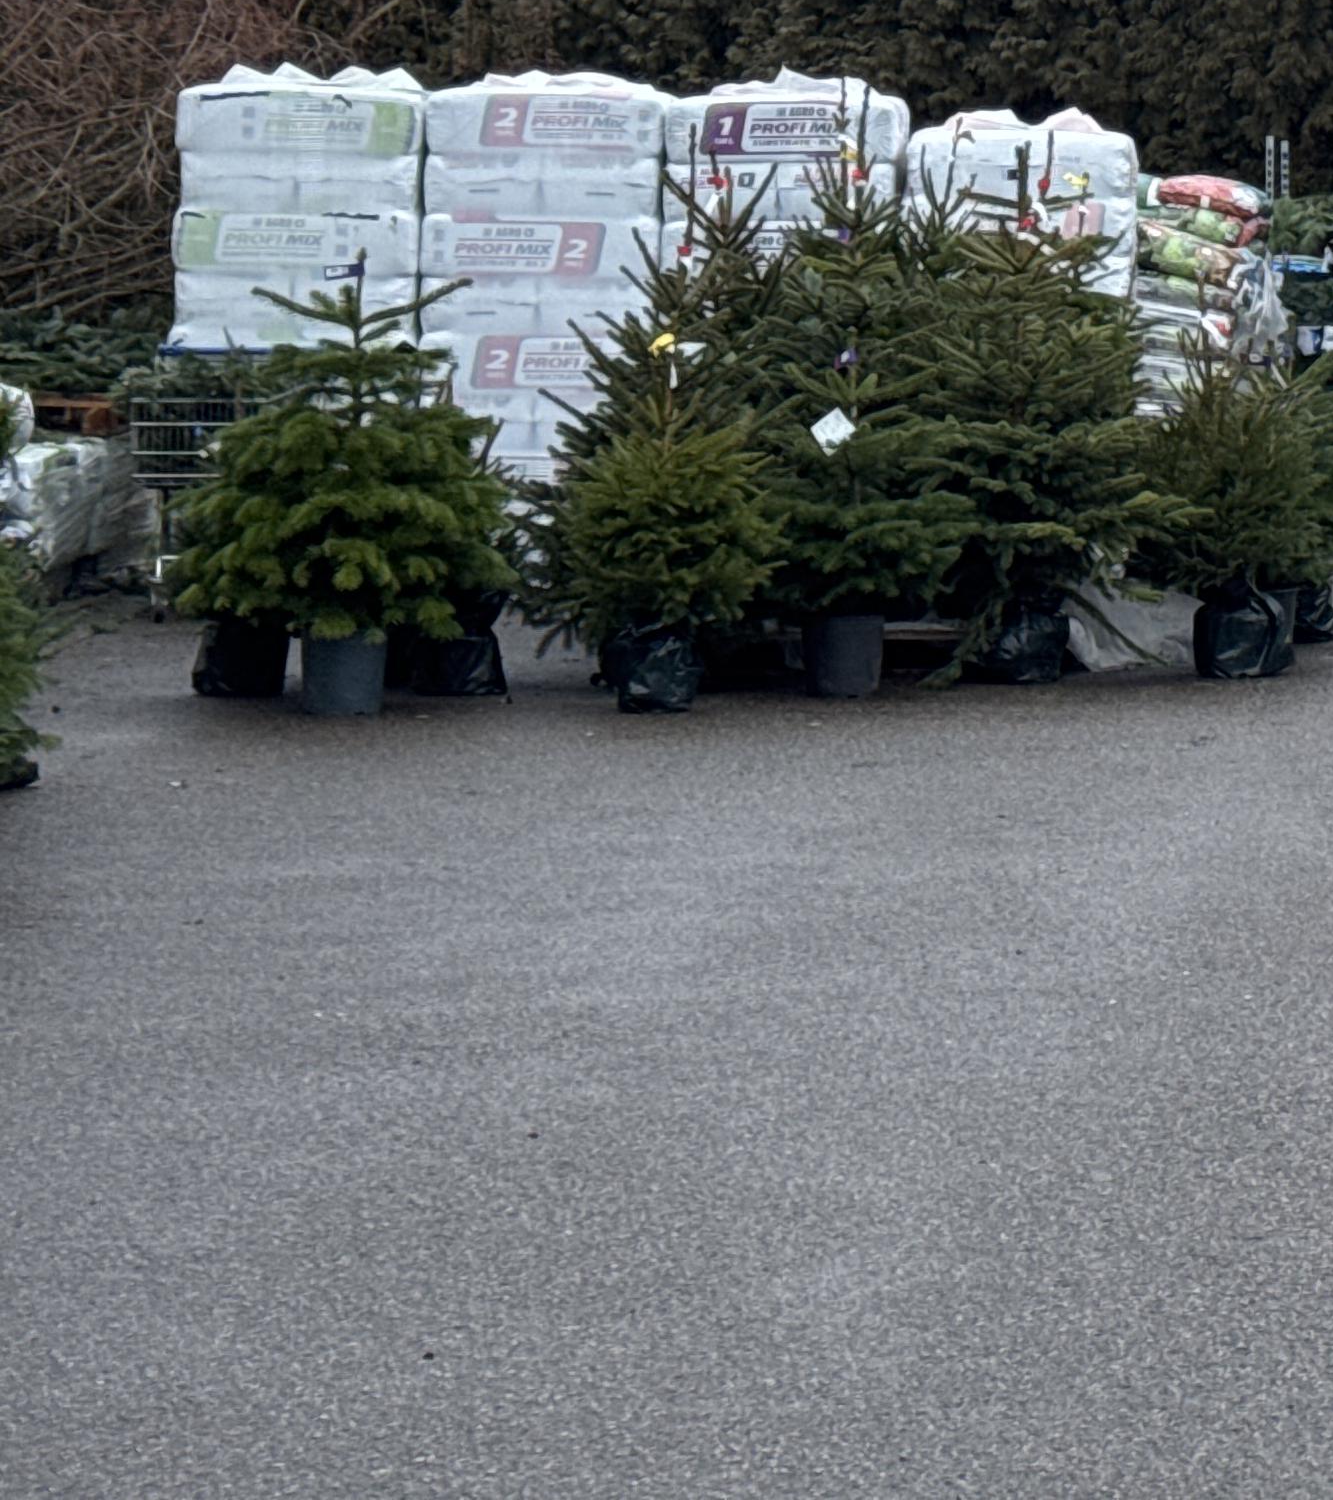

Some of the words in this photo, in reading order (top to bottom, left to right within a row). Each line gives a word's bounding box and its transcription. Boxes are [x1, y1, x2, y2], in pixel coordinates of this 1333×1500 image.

[494, 107, 518, 127] 2
[531, 115, 589, 128] PROFI
[592, 117, 627, 129] MIX
[718, 116, 735, 137] 1
[750, 122, 806, 135] PROFI
[224, 233, 283, 245] PROFI
[285, 234, 325, 246] MIX
[454, 242, 511, 255] PROFI
[514, 244, 553, 256] MIX
[563, 238, 588, 258] 2
[485, 350, 510, 369] 2
[523, 356, 581, 368] PROFI
